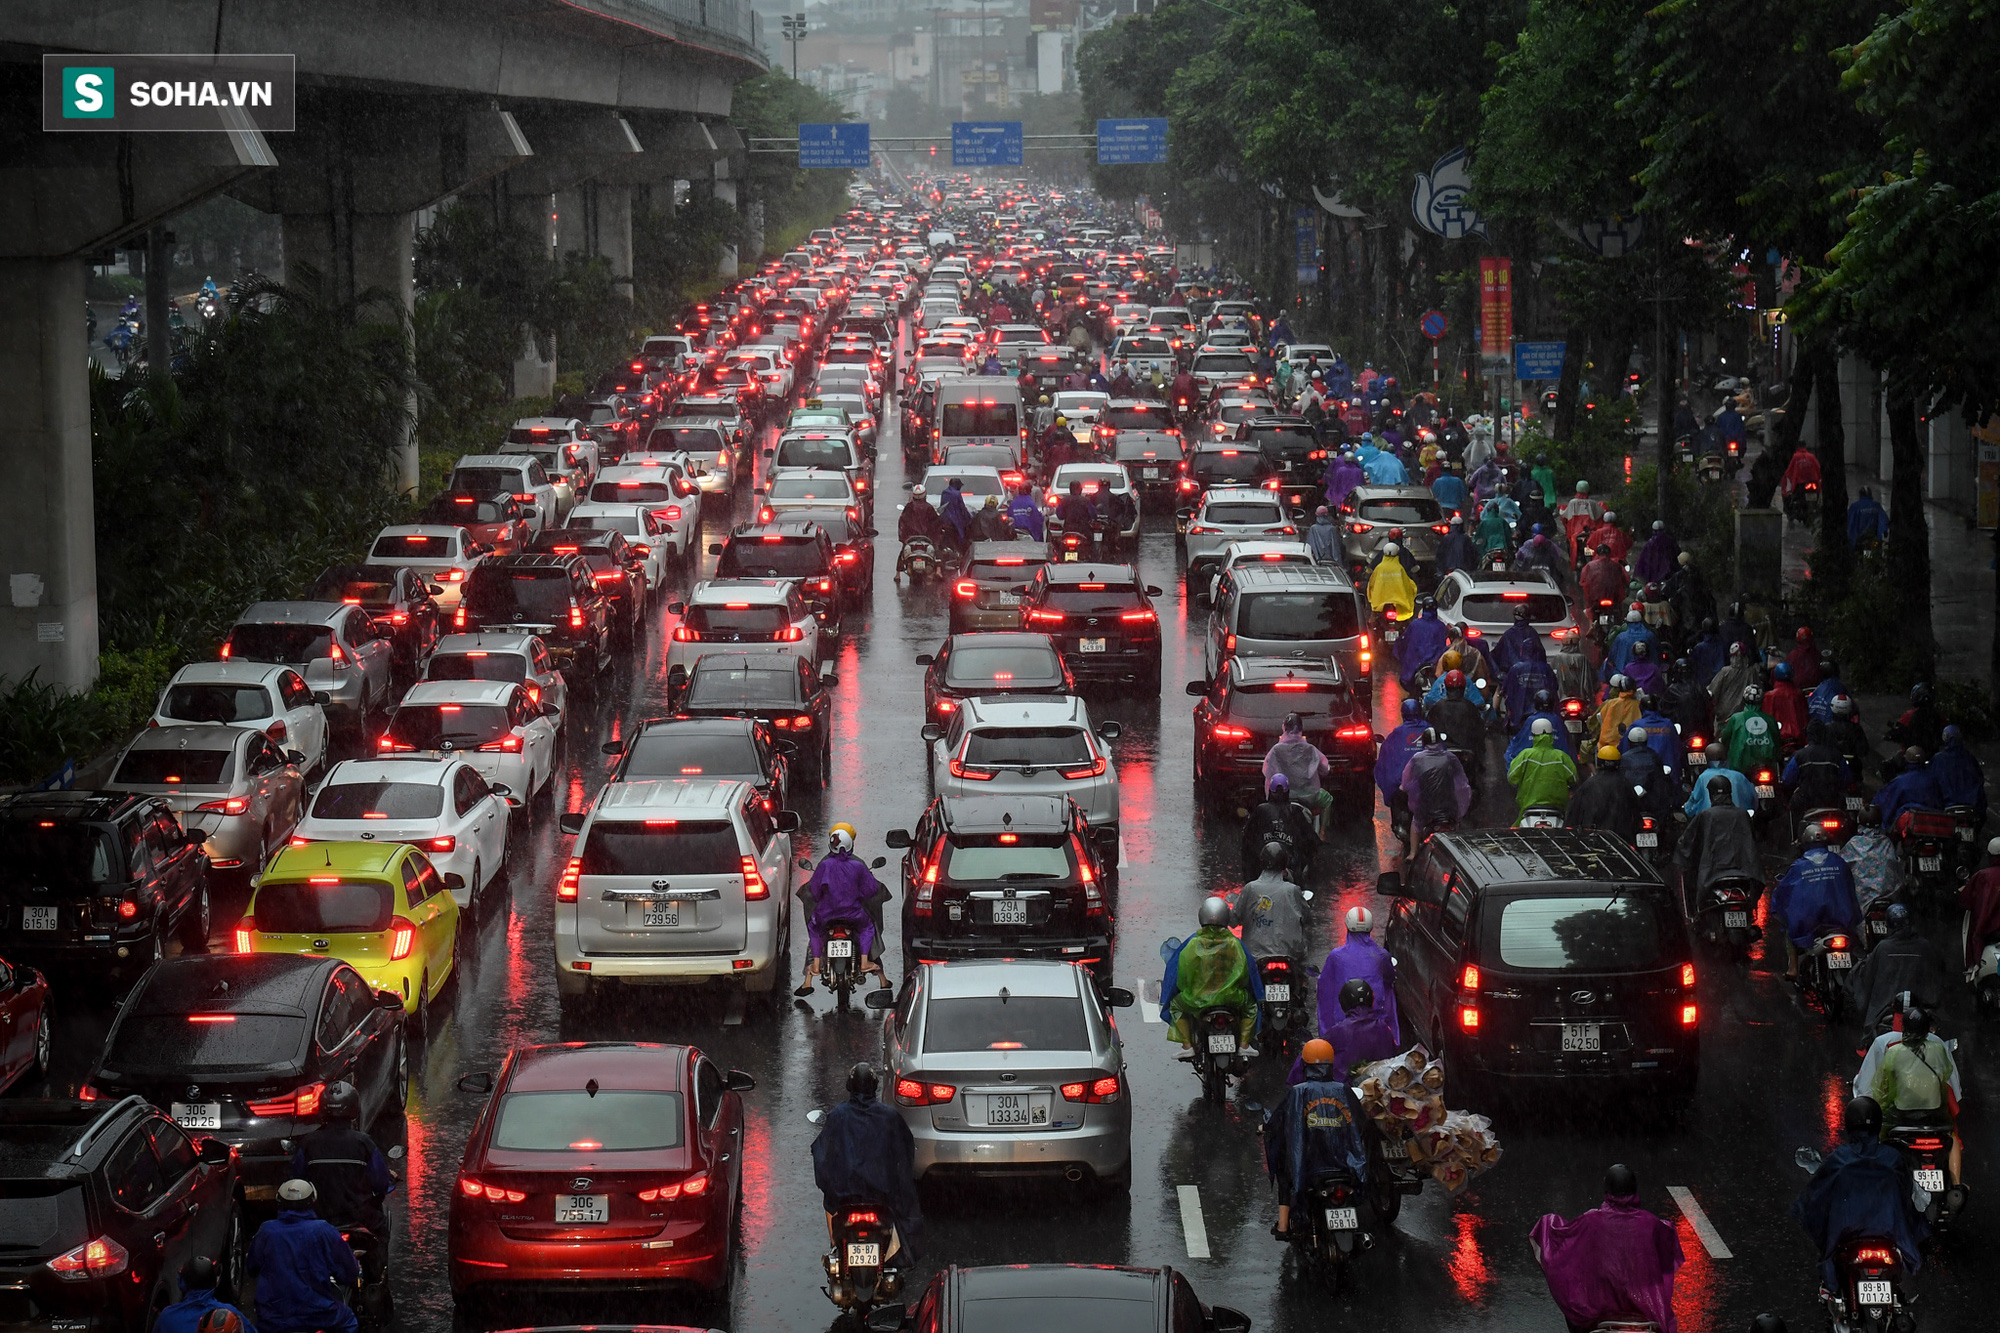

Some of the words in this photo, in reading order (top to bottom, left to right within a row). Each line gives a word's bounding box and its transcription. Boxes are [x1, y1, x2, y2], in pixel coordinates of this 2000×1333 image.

[1746, 737, 1770, 746] Grab
[652, 902, 669, 913] 30F
[1001, 901, 1018, 912] 29A
[32, 907, 49, 918] 30A
[994, 912, 1026, 923] 039.38
[24, 919, 56, 929] 615.19
[645, 914, 678, 925] 739.56
[1571, 1026, 1589, 1037] 51F
[1212, 1036, 1231, 1044] 34-F1
[1564, 1038, 1598, 1050] 842.50
[1210, 1044, 1235, 1053] 055.75
[998, 1097, 1019, 1108] 30A
[185, 1105, 206, 1116] 30G
[991, 1111, 1027, 1122] 133.34
[177, 1117, 215, 1127] 530.26
[1918, 1171, 1939, 1180] 99-F1
[1916, 1180, 1942, 1189] 42.61
[571, 1197, 593, 1208] 30G
[561, 1210, 603, 1221] 755.17
[1330, 1210, 1352, 1219] 29-X7
[1329, 1219, 1356, 1228] 058.16
[853, 1245, 874, 1254] 36-B7
[850, 1256, 877, 1265] 029.28
[1863, 1283, 1886, 1292] 89-B1
[1861, 1293, 1890, 1303] 701.23
